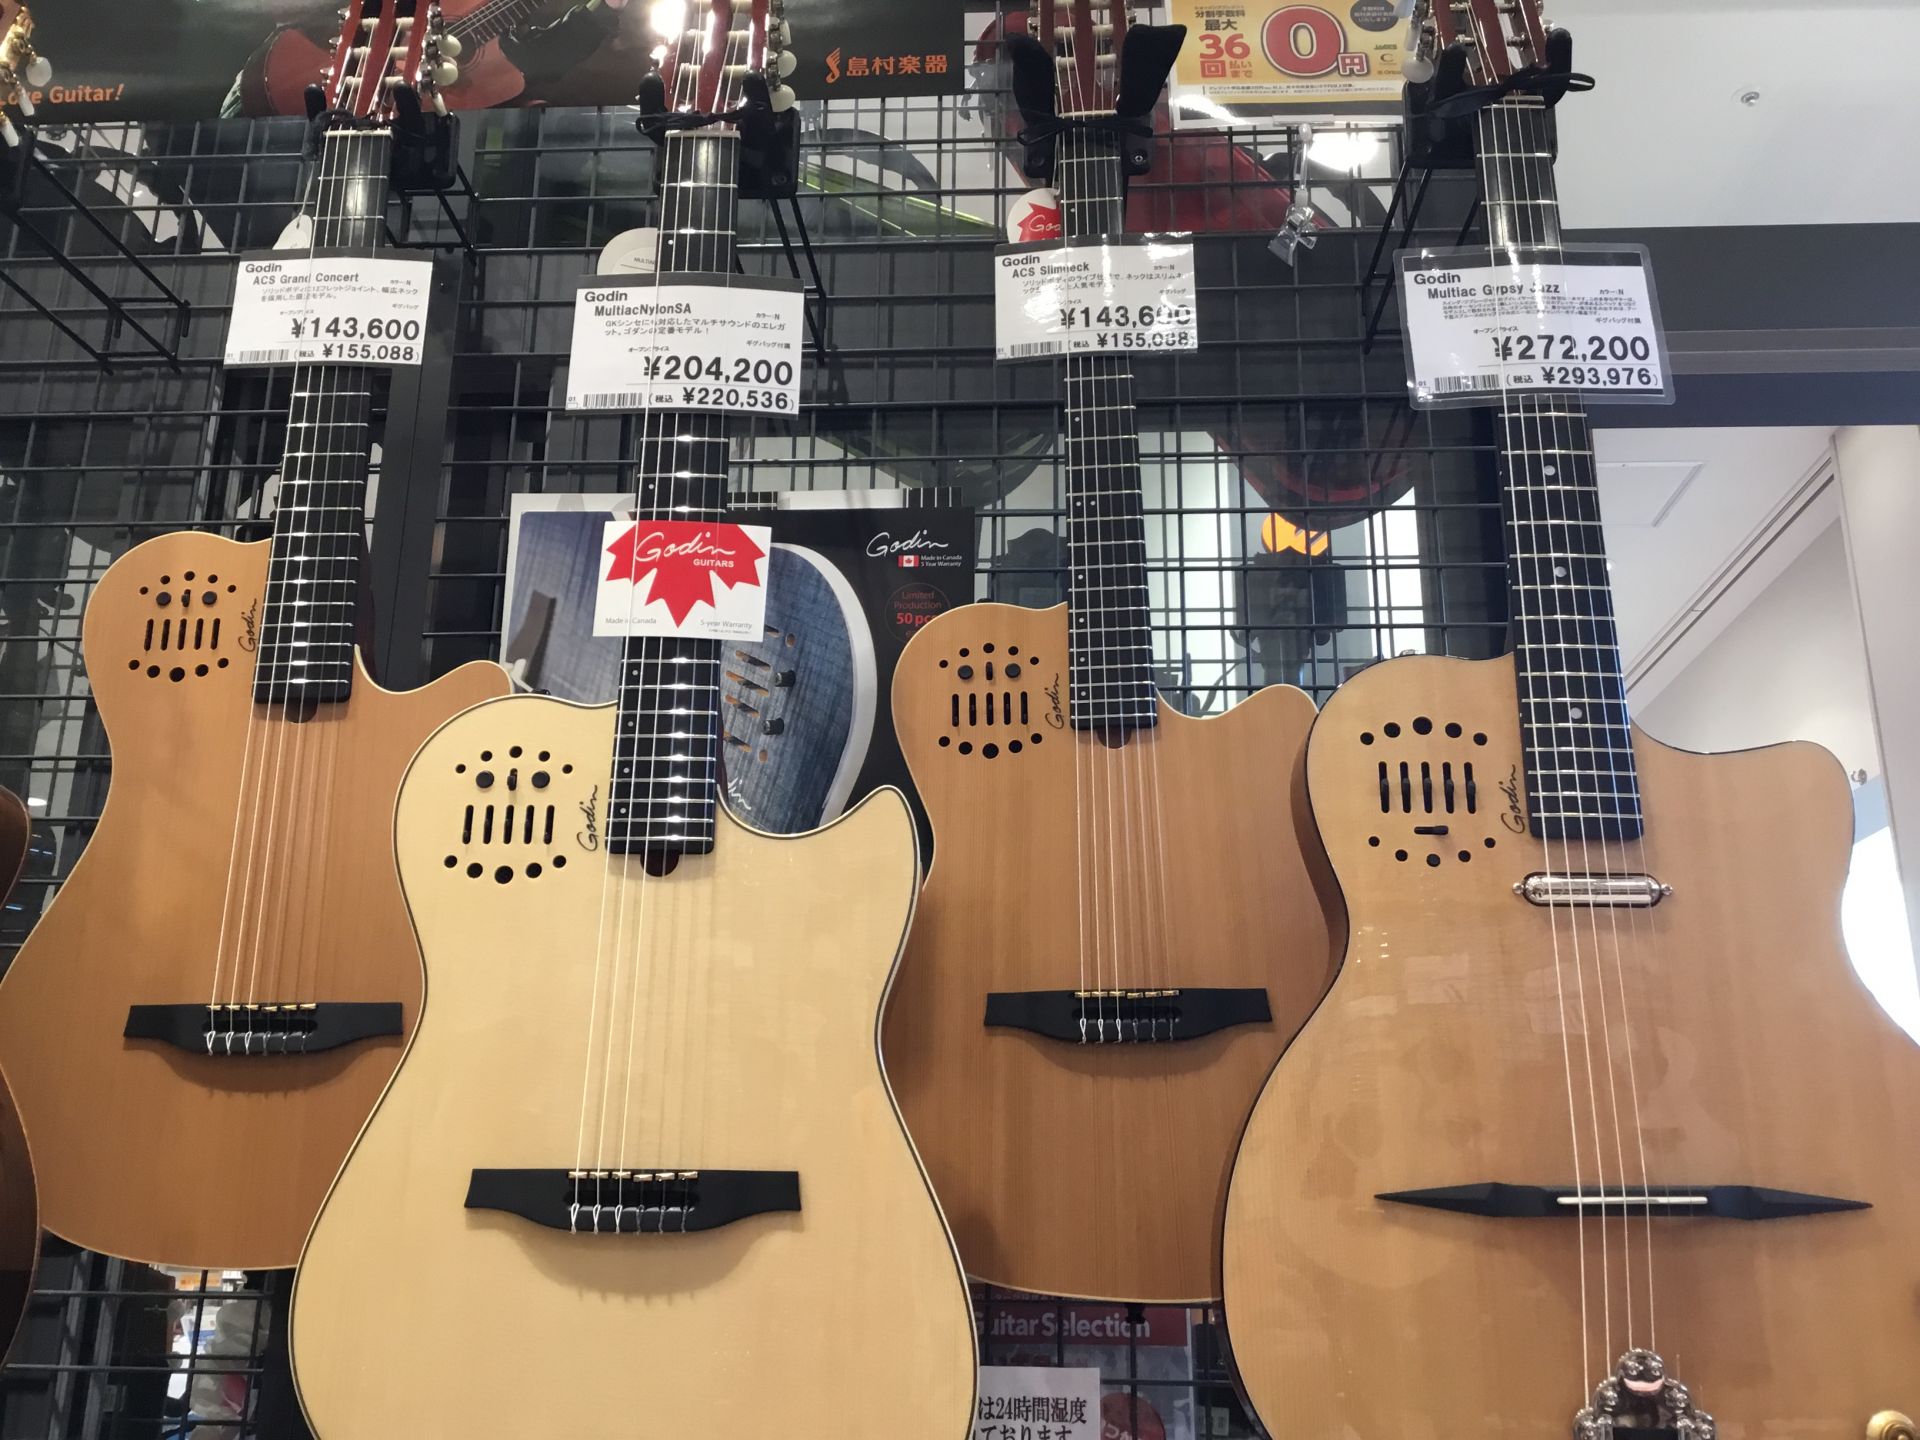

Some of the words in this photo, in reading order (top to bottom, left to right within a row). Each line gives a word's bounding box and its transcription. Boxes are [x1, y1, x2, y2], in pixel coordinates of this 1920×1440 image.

[1205, 19, 1238, 31] 最大
[1199, 33, 1250, 60] 36
[846, 54, 948, 77] 島村楽器
[49, 83, 125, 104] Guitar!
[245, 263, 282, 273] Godin
[1002, 255, 1040, 267] Godin
[253, 275, 276, 285] ACS
[280, 274, 311, 284] Grand
[315, 272, 359, 283] Concert
[1012, 268, 1035, 279] ACS
[1040, 262, 1090, 275] Slimneck
[1413, 272, 1461, 285] Godin
[584, 290, 628, 302] Godin
[1428, 286, 1477, 299] Multiac
[1482, 284, 1524, 297] Gypsy
[594, 302, 692, 317] MultiacNylonSA
[1060, 305, 1191, 329] ¥143,600
[291, 316, 420, 340] ¥143,600
[1492, 334, 1650, 362] ¥272,200
[643, 355, 793, 385] ¥204,200
[635, 531, 736, 562] Godin
[866, 529, 949, 557] Godin
[693, 558, 735, 568] GUITARS
[902, 591, 935, 599] Limited
[893, 600, 942, 609] Production
[238, 598, 257, 652] Godin
[605, 617, 623, 625] Made
[631, 617, 657, 625] Canada
[700, 619, 720, 628] 5-year
[722, 620, 753, 629] Warranty
[896, 612, 913, 625] 50
[1045, 673, 1064, 729] Godin
[1498, 764, 1527, 834] Godin
[576, 784, 599, 852] Godin
